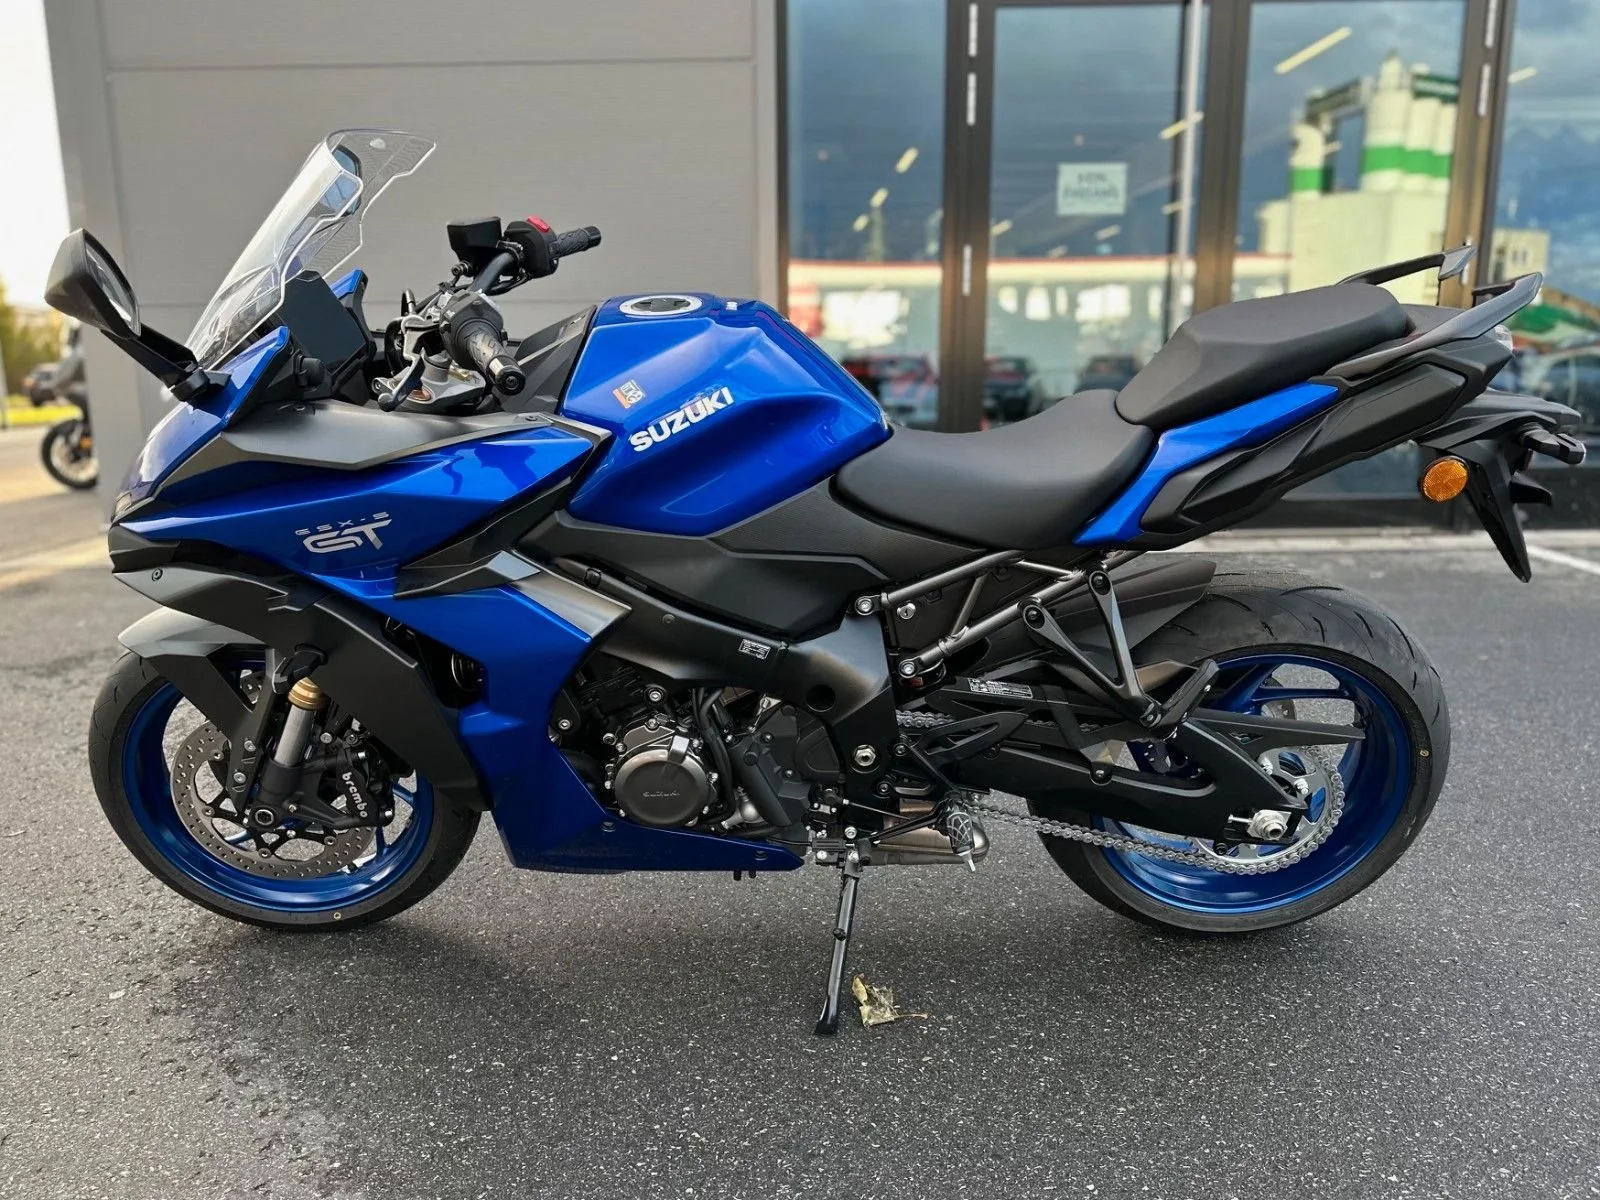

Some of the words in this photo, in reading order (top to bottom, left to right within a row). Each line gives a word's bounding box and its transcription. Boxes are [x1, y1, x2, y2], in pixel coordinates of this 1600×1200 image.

[629, 386, 735, 452] SUZUKI
[302, 518, 393, 554] GT
[341, 771, 369, 818] brembo
